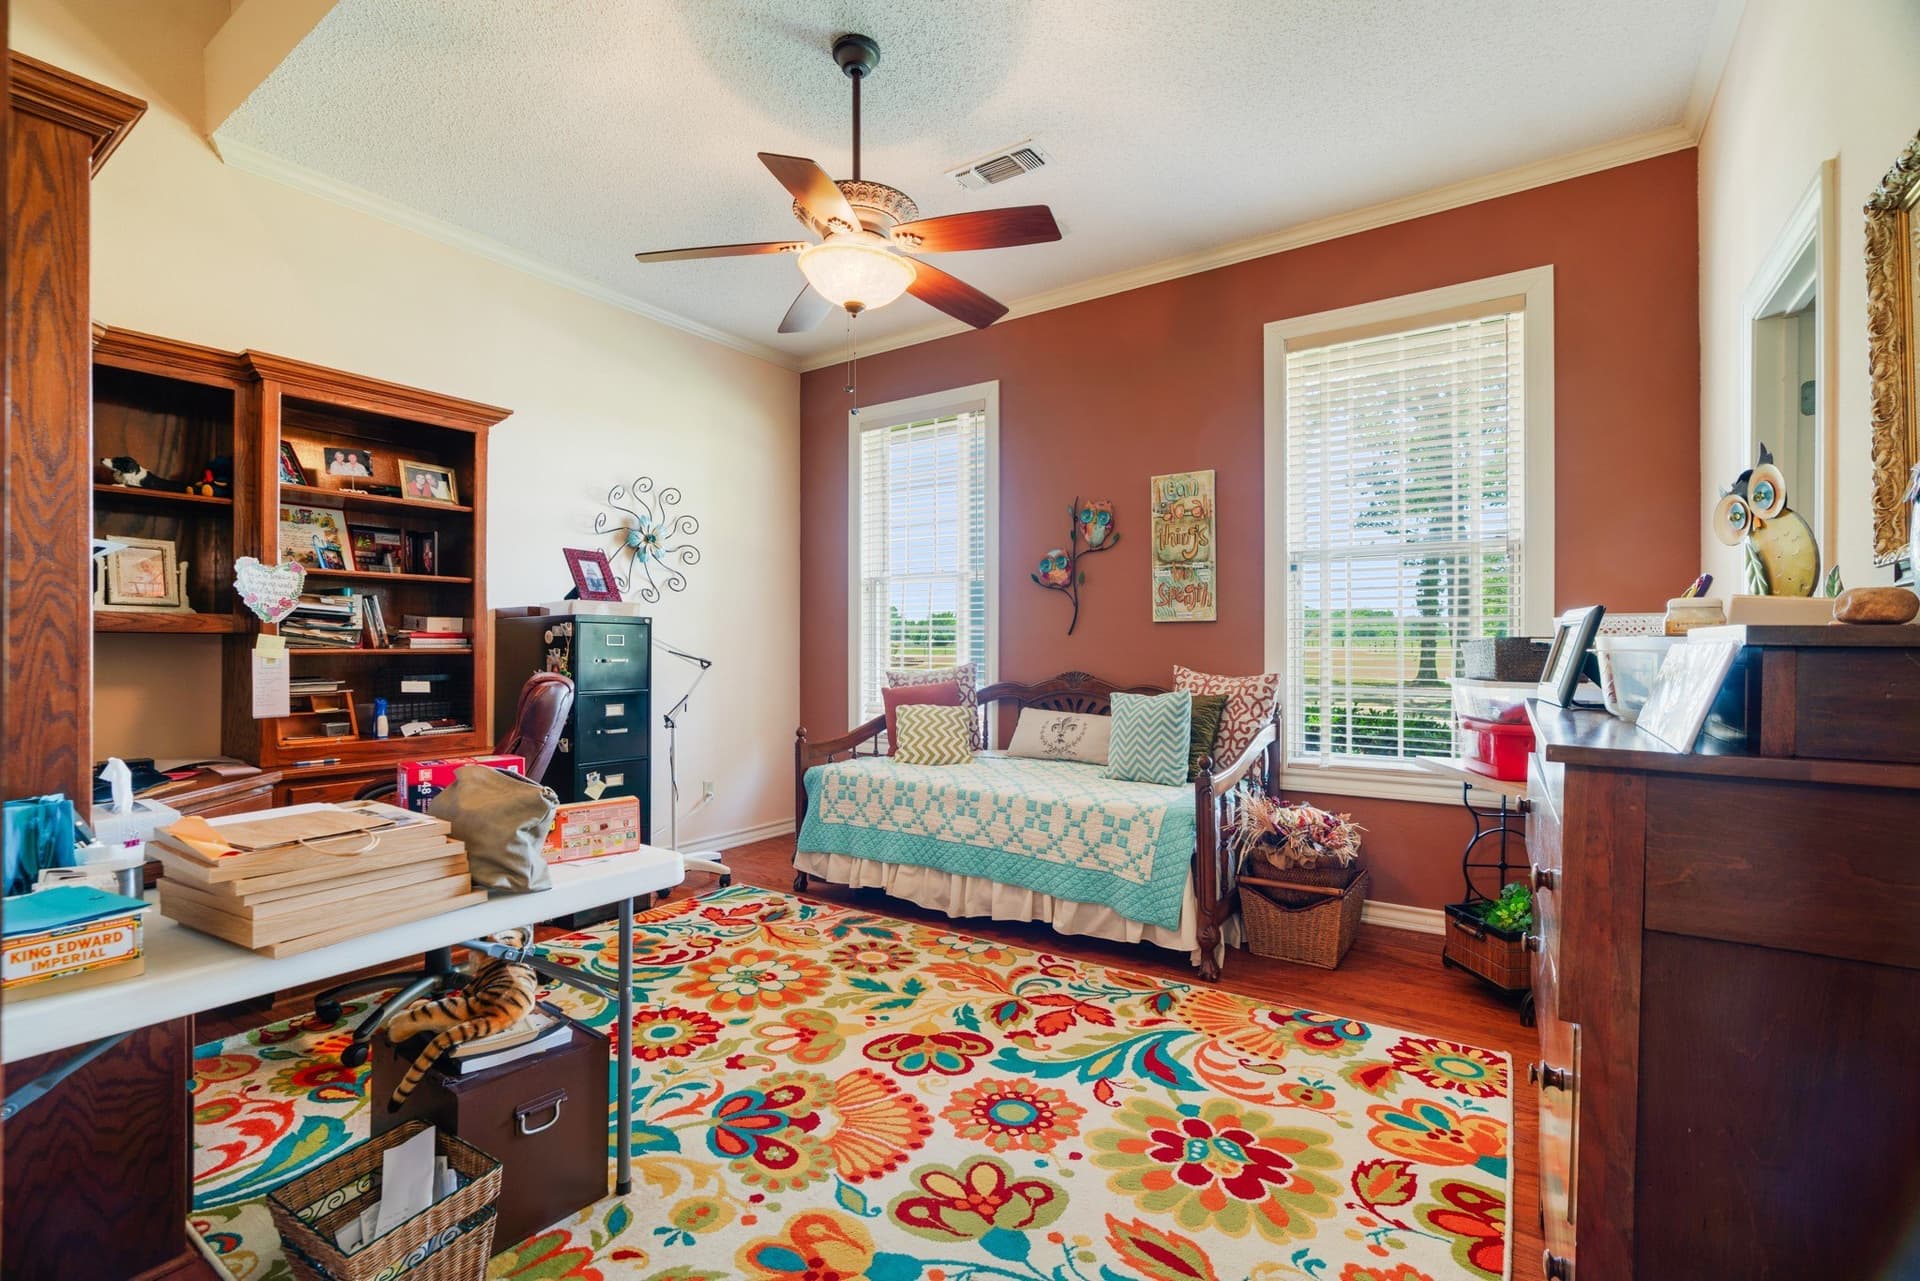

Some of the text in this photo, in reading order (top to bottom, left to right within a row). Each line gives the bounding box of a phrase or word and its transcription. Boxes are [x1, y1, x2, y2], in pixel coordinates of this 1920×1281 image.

[1159, 524, 1209, 560] things
[421, 781, 432, 795] 48
[10, 946, 52, 964] KING
[57, 931, 123, 953] EDWARD
[31, 948, 106, 971] IMPERIAL
